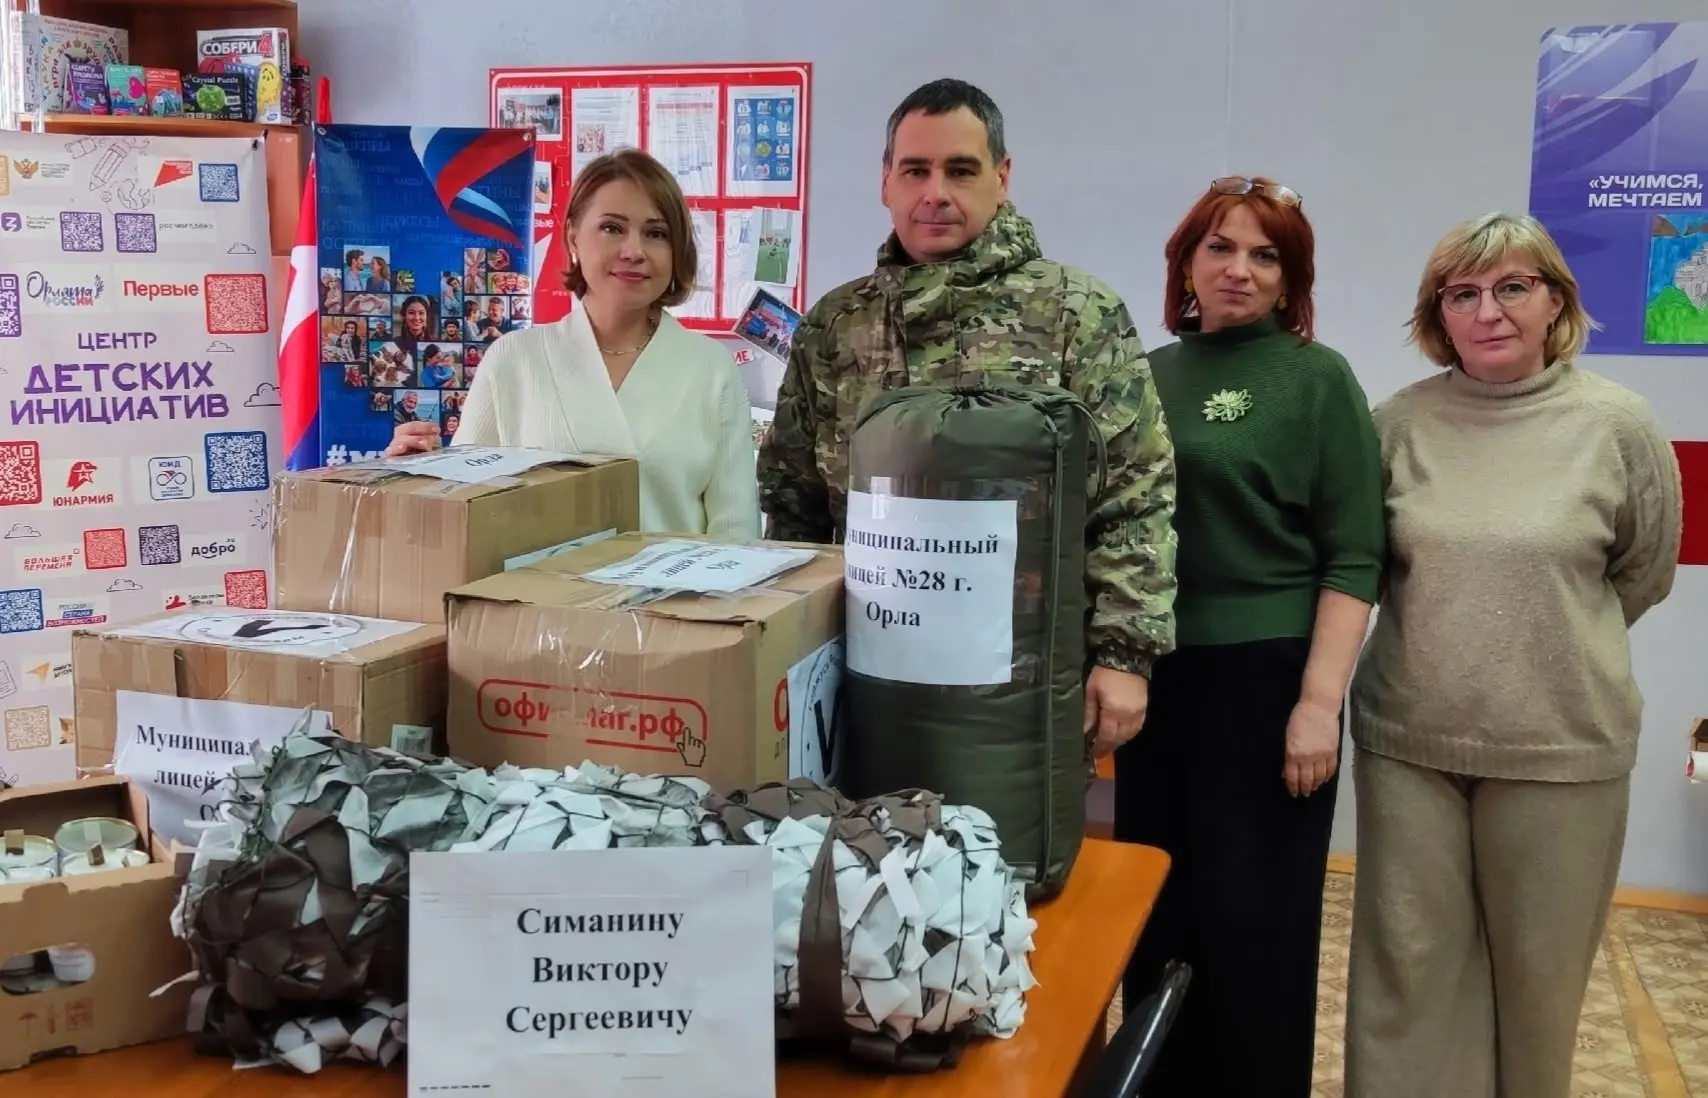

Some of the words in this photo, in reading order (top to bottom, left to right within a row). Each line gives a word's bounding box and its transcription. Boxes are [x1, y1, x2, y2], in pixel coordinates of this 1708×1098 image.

[202, 41, 257, 55] СОБЕРИ
[258, 32, 274, 57] 4
[1589, 174, 1704, 189] «УЧИМСЯ,
[1588, 193, 1702, 207] МЕЧТАЕМ
[123, 280, 199, 301] Первые
[78, 332, 157, 350] ЦЕНТР
[24, 361, 215, 394] ДЕТСКИХ
[10, 393, 229, 425] ИНИЦИАТИВ
[53, 494, 114, 507] ЮНАРМИЯ
[191, 542, 236, 557] добро
[893, 569, 945, 591] №28
[955, 577, 972, 592] г.
[866, 602, 921, 629] Орла
[517, 908, 684, 938] Симанину
[533, 957, 669, 987] Виктору
[506, 1006, 693, 1038] Сергеевичу
